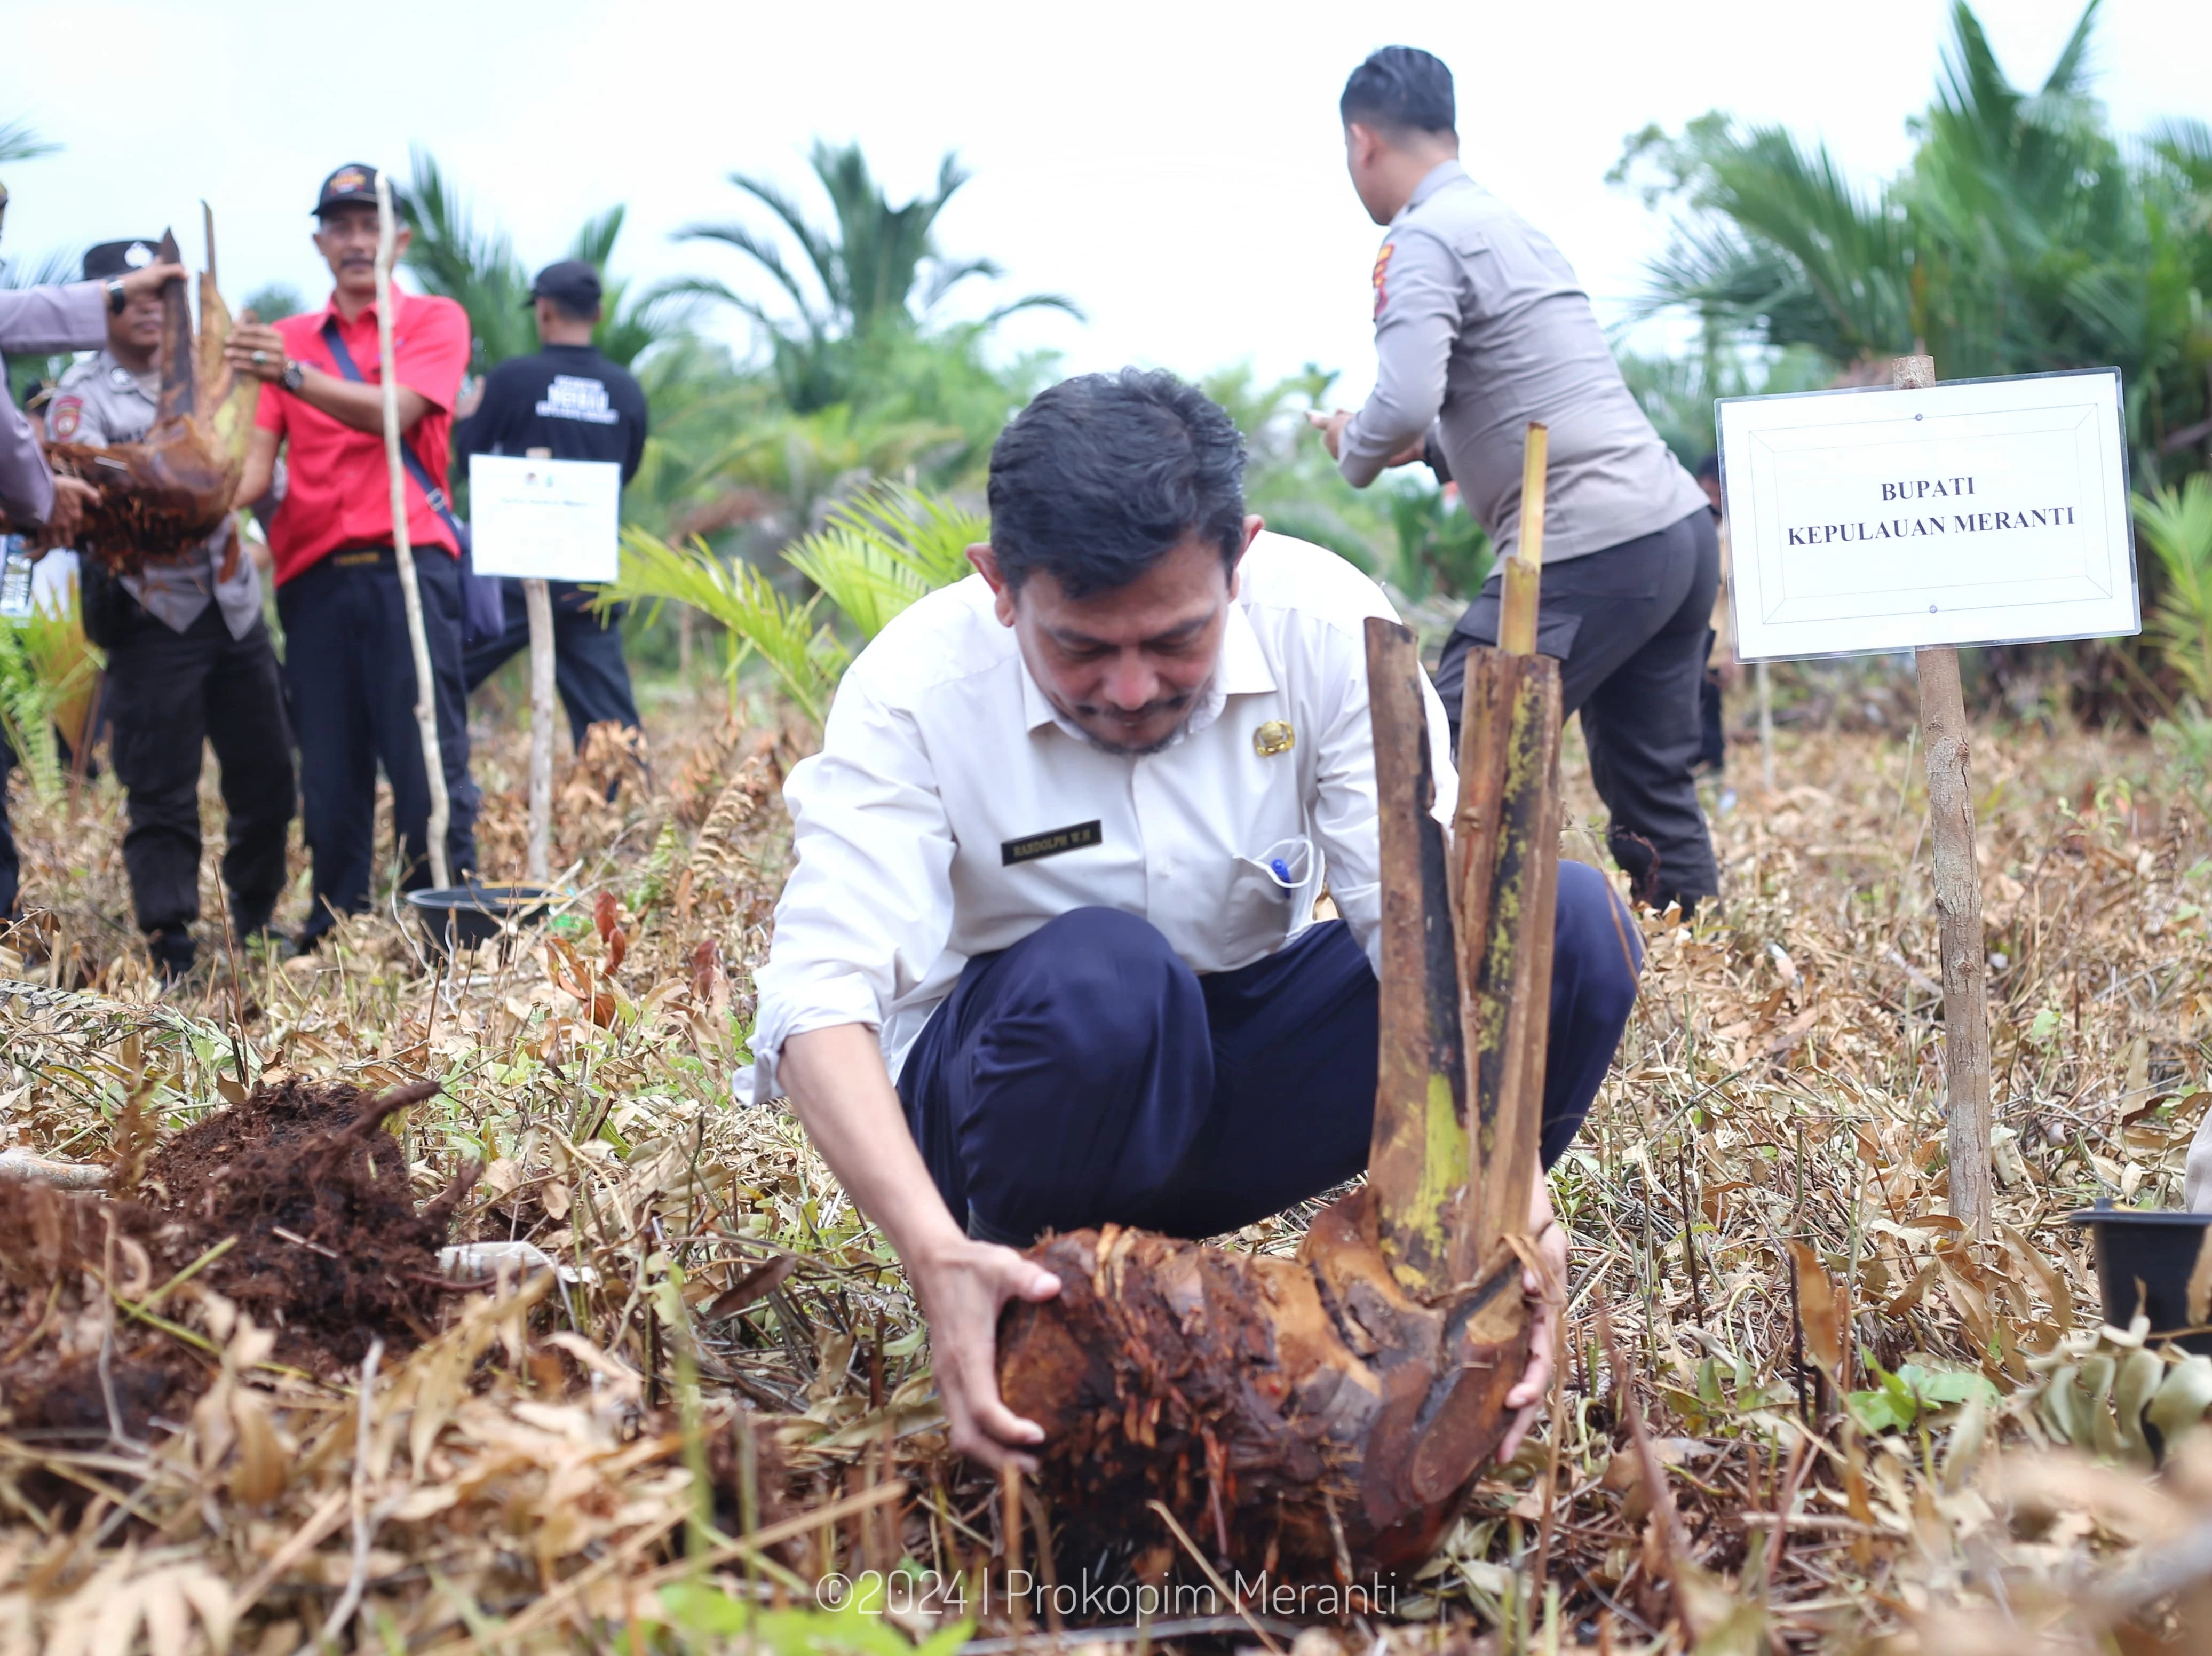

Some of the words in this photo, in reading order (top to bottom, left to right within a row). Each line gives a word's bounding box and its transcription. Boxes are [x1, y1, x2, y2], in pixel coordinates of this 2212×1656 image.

[1881, 476, 1976, 502] BUPATI
[1787, 515, 1946, 546] KEPULAUAN
[1953, 506, 2075, 533] MERANTI
